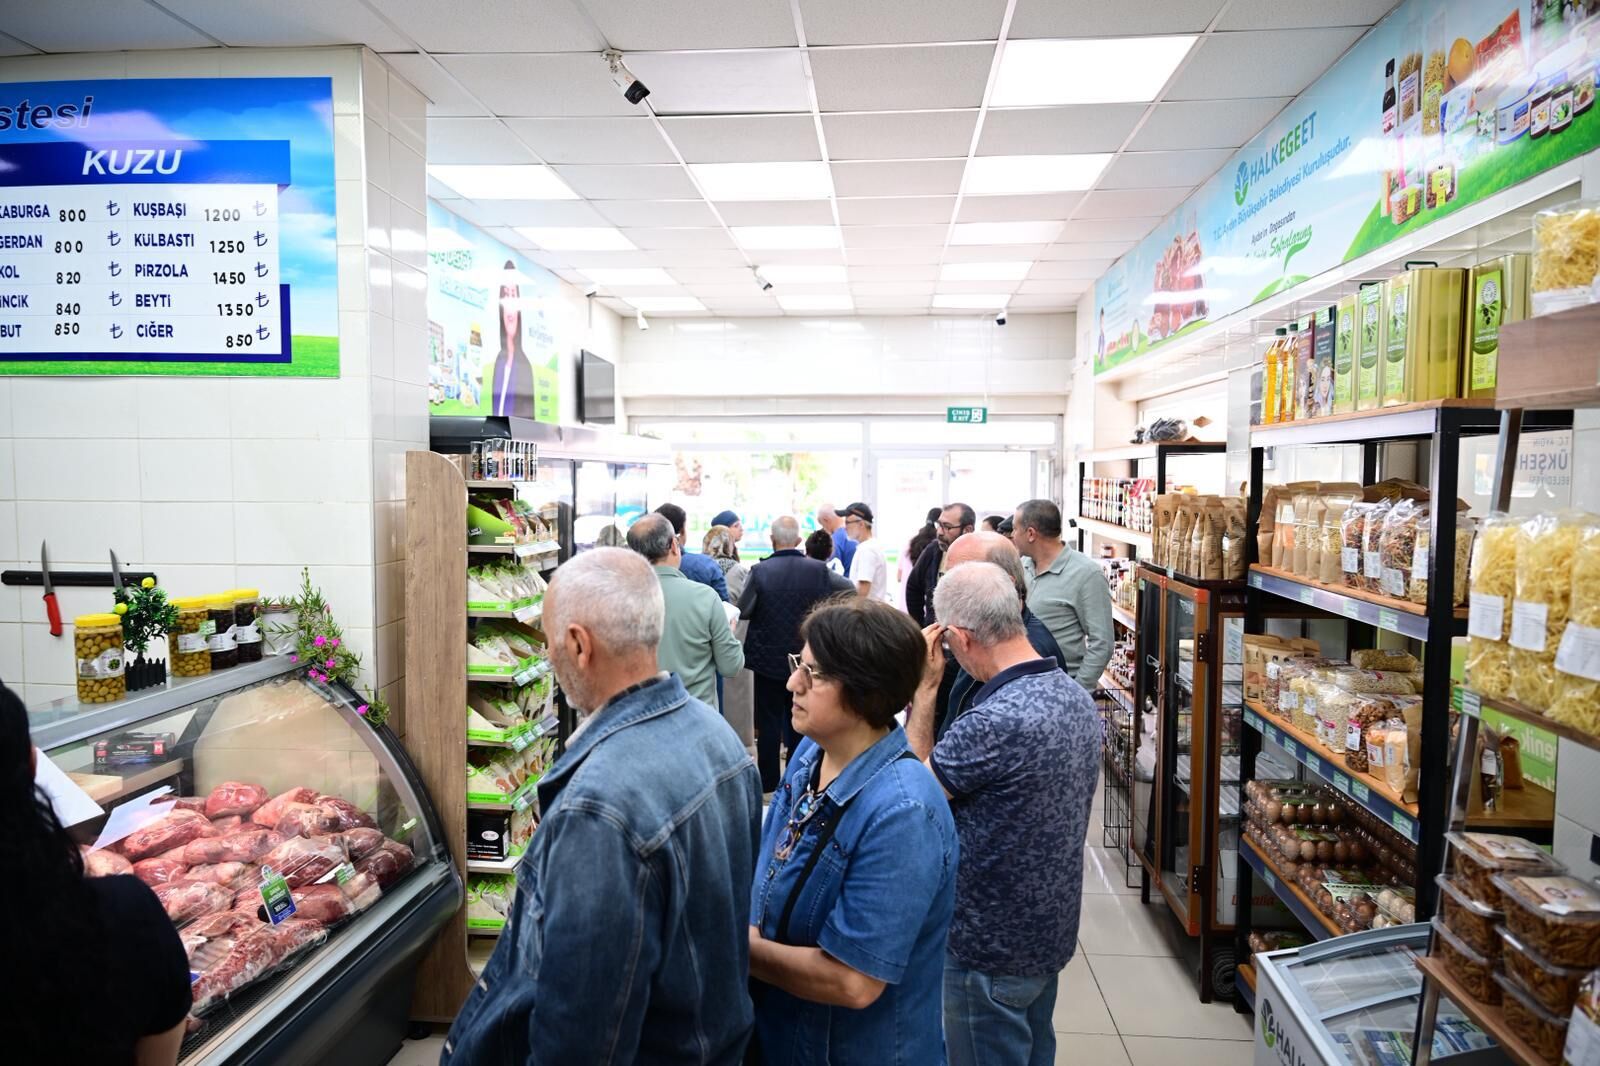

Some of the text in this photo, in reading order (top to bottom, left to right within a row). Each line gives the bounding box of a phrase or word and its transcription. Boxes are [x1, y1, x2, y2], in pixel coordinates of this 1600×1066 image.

[1249, 110, 1317, 186] HALKEGEET
[82, 149, 182, 175] KUZU
[1237, 192, 1268, 224] Büyükşehir
[1269, 167, 1302, 203] Belediyesi
[1302, 136, 1351, 180] Kuruluşudur.
[59, 209, 86, 222] 800
[133, 202, 186, 219] KUŞBAŞI
[205, 209, 241, 222] 1200
[55, 241, 83, 254] 800
[134, 233, 195, 247] KÜLBASTI
[209, 241, 245, 253] 1250
[56, 272, 81, 285] 820
[134, 263, 189, 278] PİRZOLA
[213, 272, 246, 285] 1450
[56, 303, 81, 316] 840
[135, 294, 171, 308] BEYTİ
[217, 303, 254, 316] 1350
[0, 324, 22, 338] BUT
[54, 323, 80, 336] 850
[136, 321, 174, 338] CİĞER
[226, 334, 253, 348] 850
